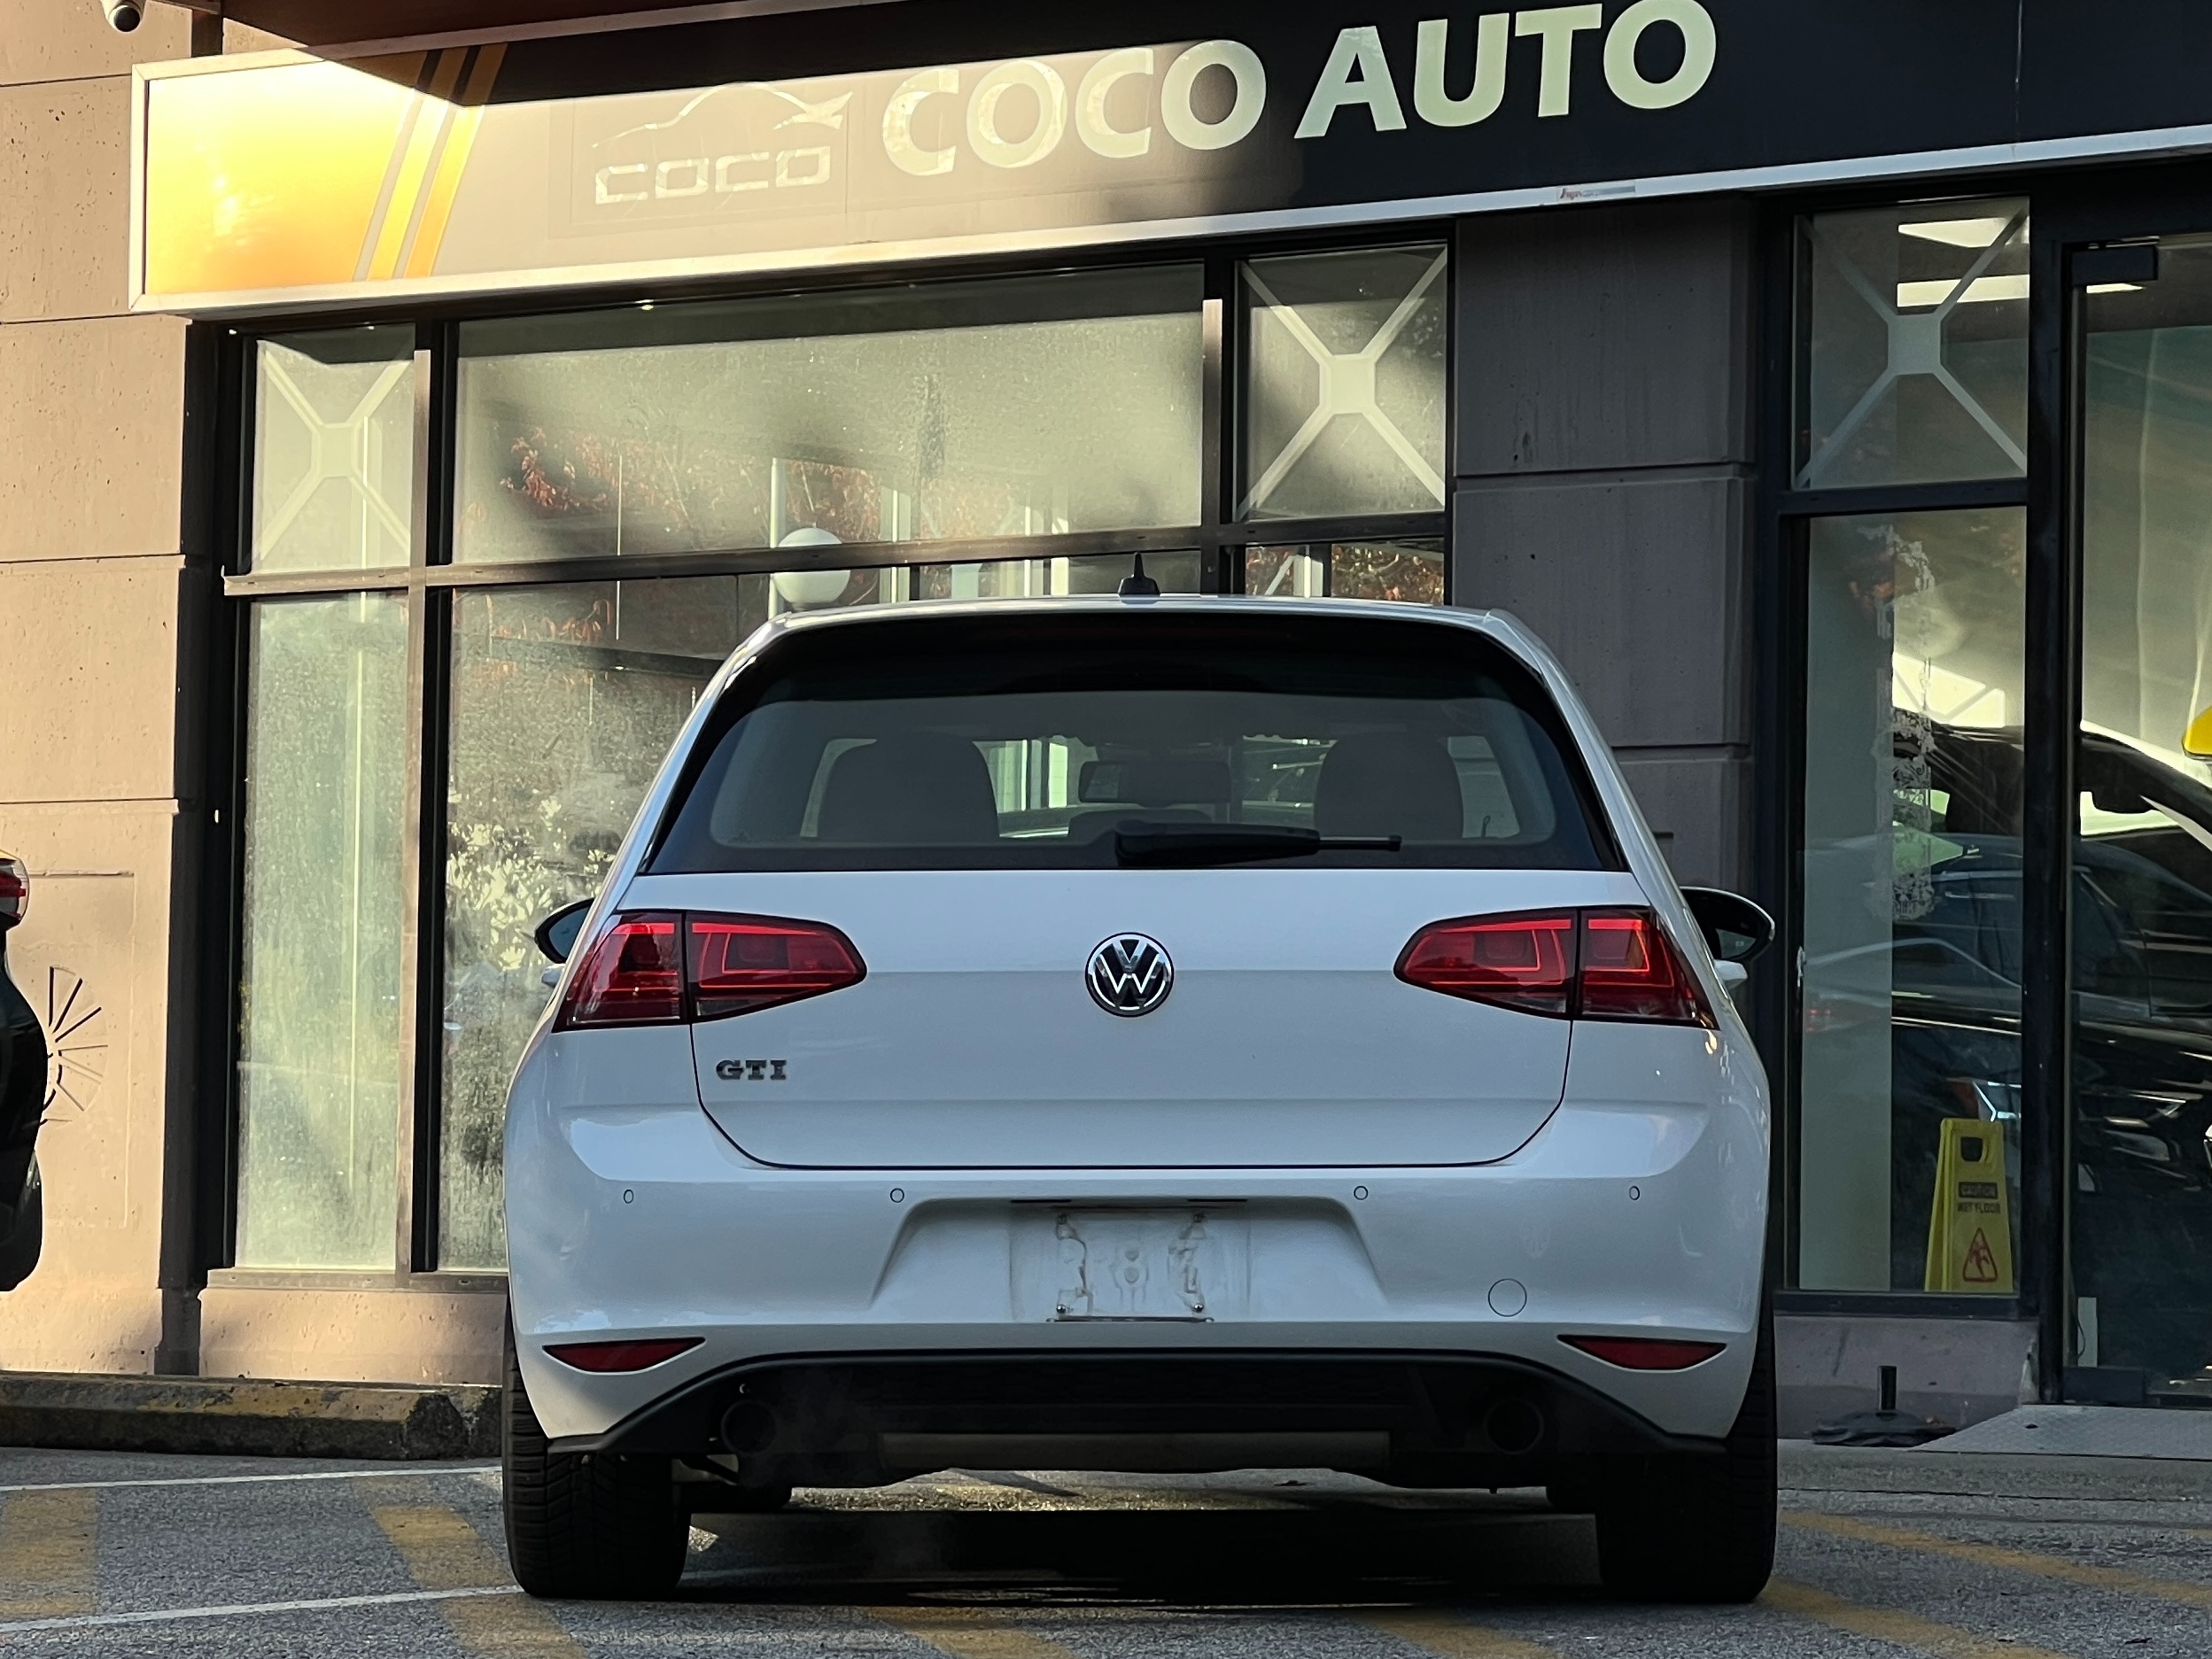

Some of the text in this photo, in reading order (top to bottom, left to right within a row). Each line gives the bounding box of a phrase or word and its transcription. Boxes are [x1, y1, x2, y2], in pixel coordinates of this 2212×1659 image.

[881, 0, 1717, 177] COCO AUTO
[1088, 934, 1172, 1015] VW
[716, 1059, 787, 1081] GTI
[1975, 1202, 2001, 1214] FLOOR
